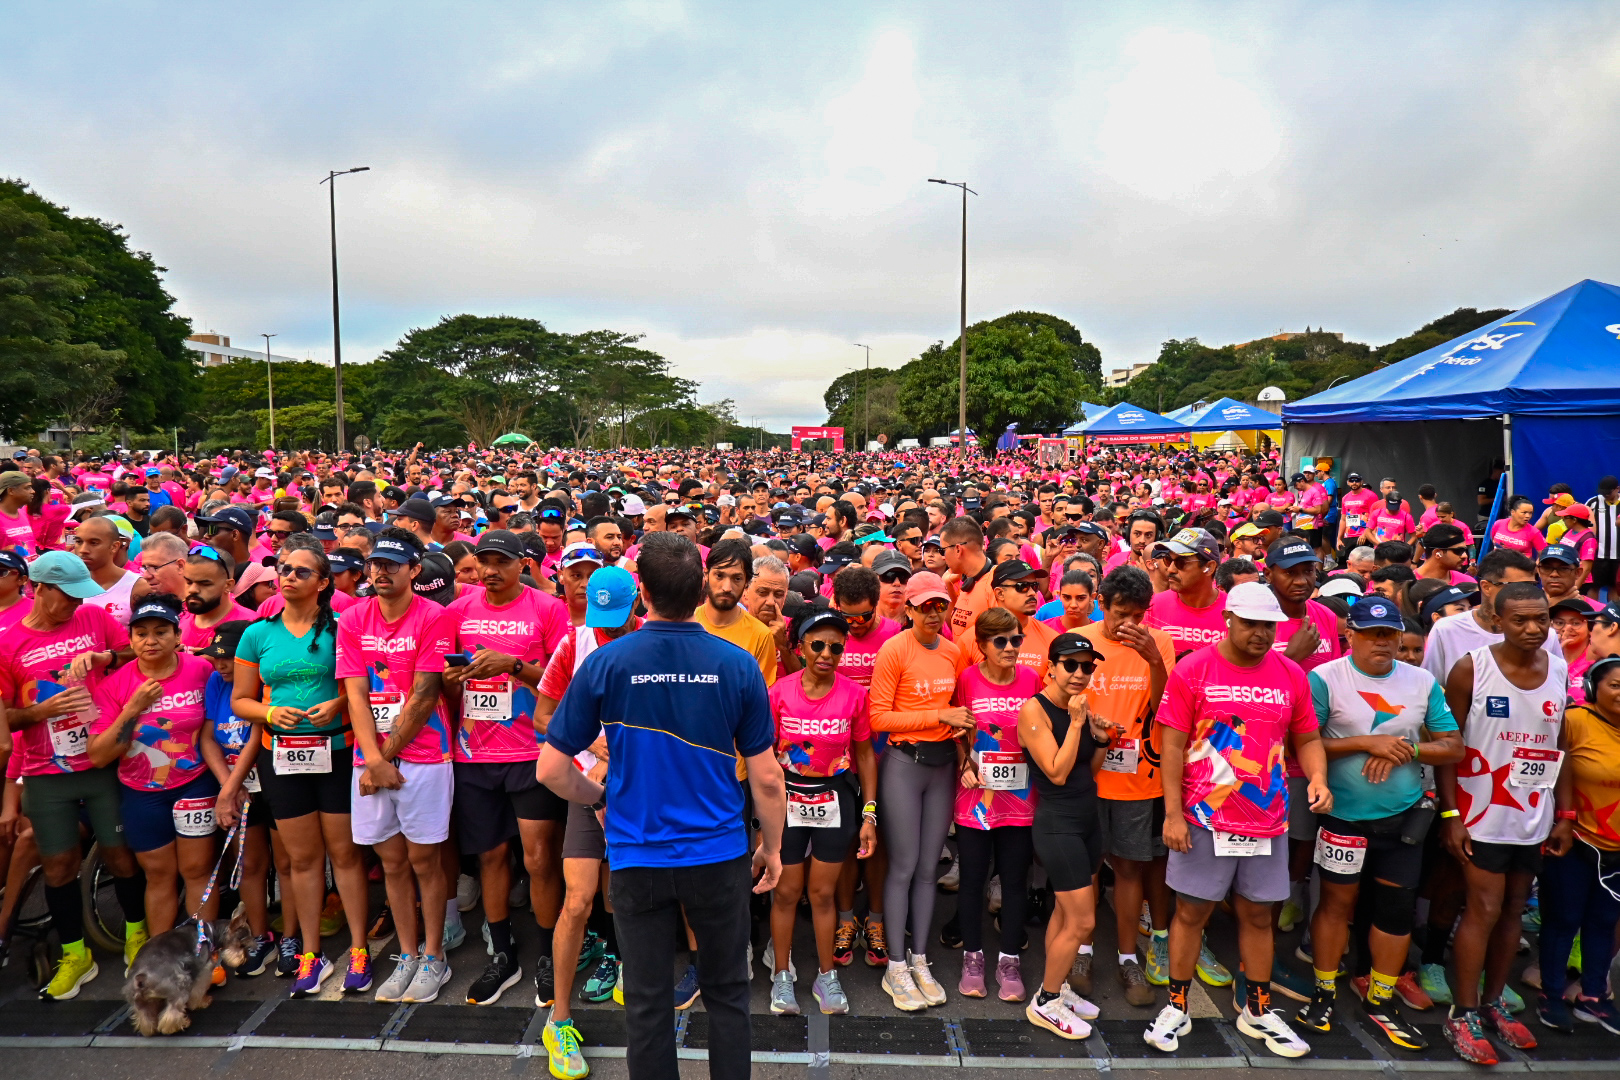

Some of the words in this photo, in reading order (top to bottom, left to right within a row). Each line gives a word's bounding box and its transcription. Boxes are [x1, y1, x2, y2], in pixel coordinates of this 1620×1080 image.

[460, 620, 529, 636] SESC21k
[1160, 625, 1227, 643] SESC21
[630, 673, 677, 684] ESPORTE
[678, 673, 686, 683] E
[687, 673, 719, 684] LAZER
[472, 693, 498, 708] 120
[1205, 685, 1286, 706] SESC21k
[972, 697, 1028, 715] SESC2
[1496, 731, 1549, 744] AEEP-DF
[287, 749, 316, 762] 867
[992, 765, 1017, 779] 881
[1520, 761, 1546, 776] 299
[184, 810, 213, 825] 185
[799, 804, 827, 818] 315
[1325, 845, 1355, 863] 306
